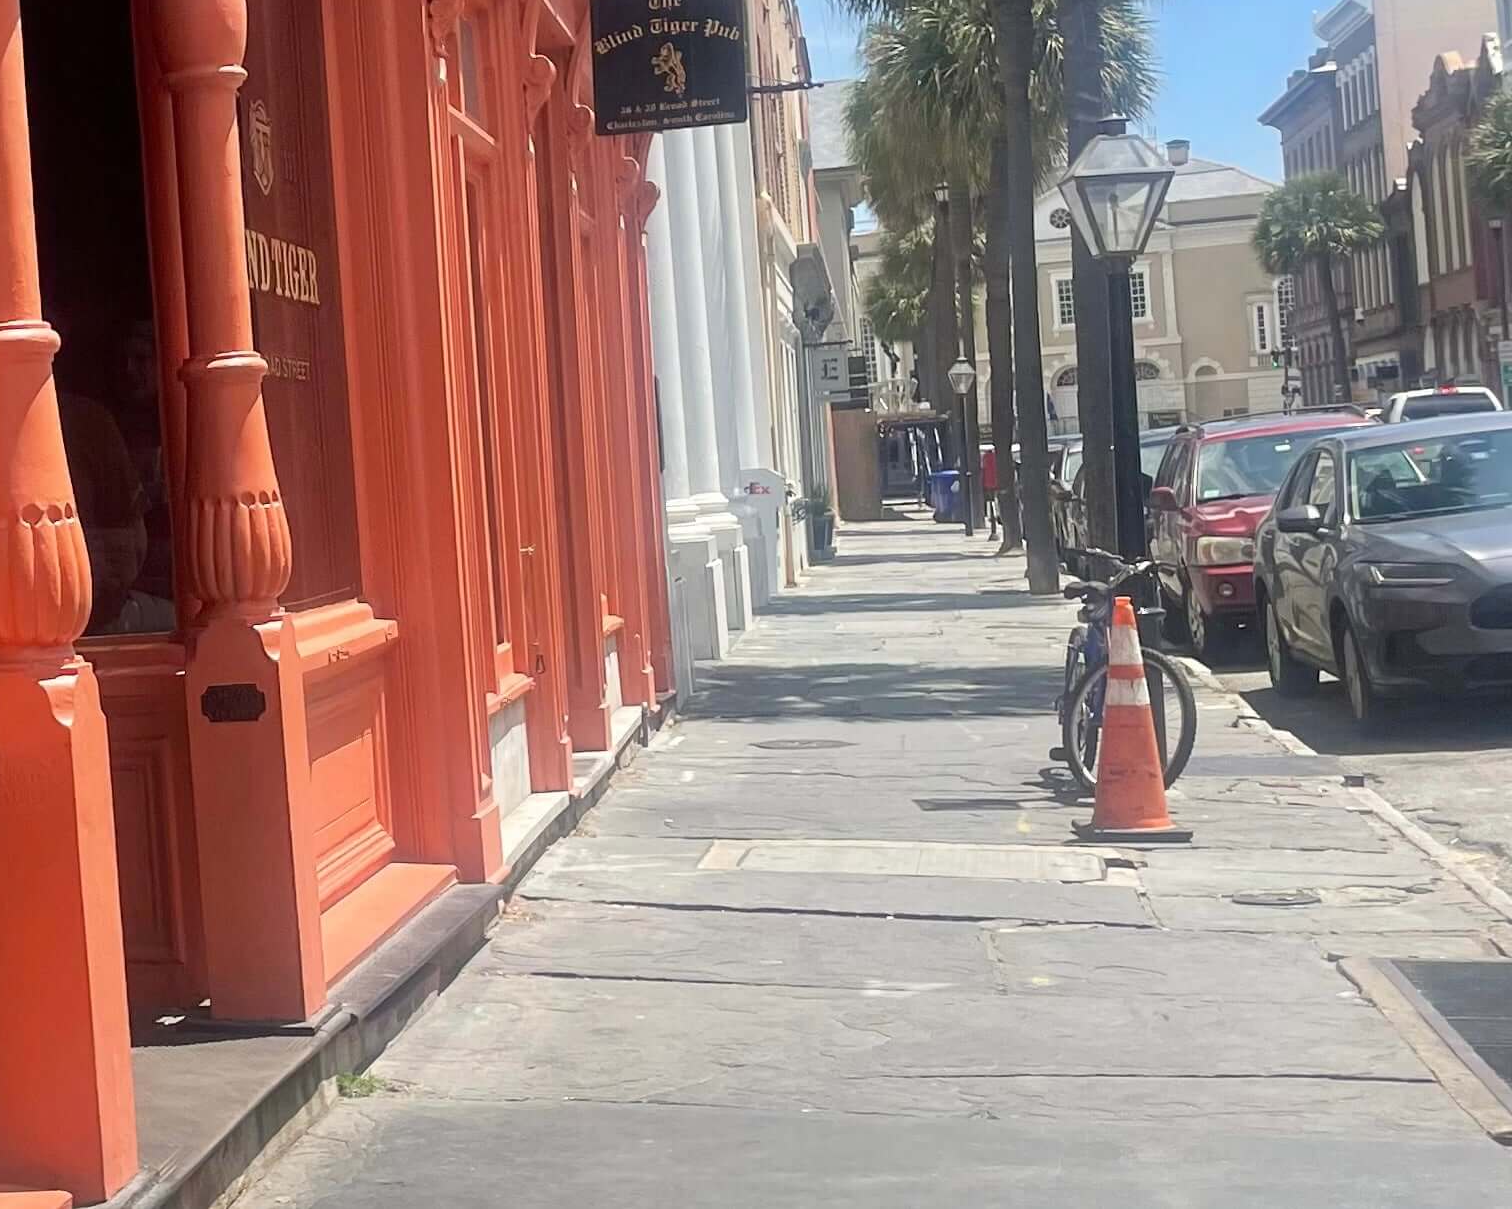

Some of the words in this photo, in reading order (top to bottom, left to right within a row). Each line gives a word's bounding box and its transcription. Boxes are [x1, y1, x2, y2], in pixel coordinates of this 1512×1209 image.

[593, 24, 644, 55] Blind
[649, 18, 699, 35] Tiger
[703, 18, 740, 41] Pub
[271, 236, 320, 305] TIGER
